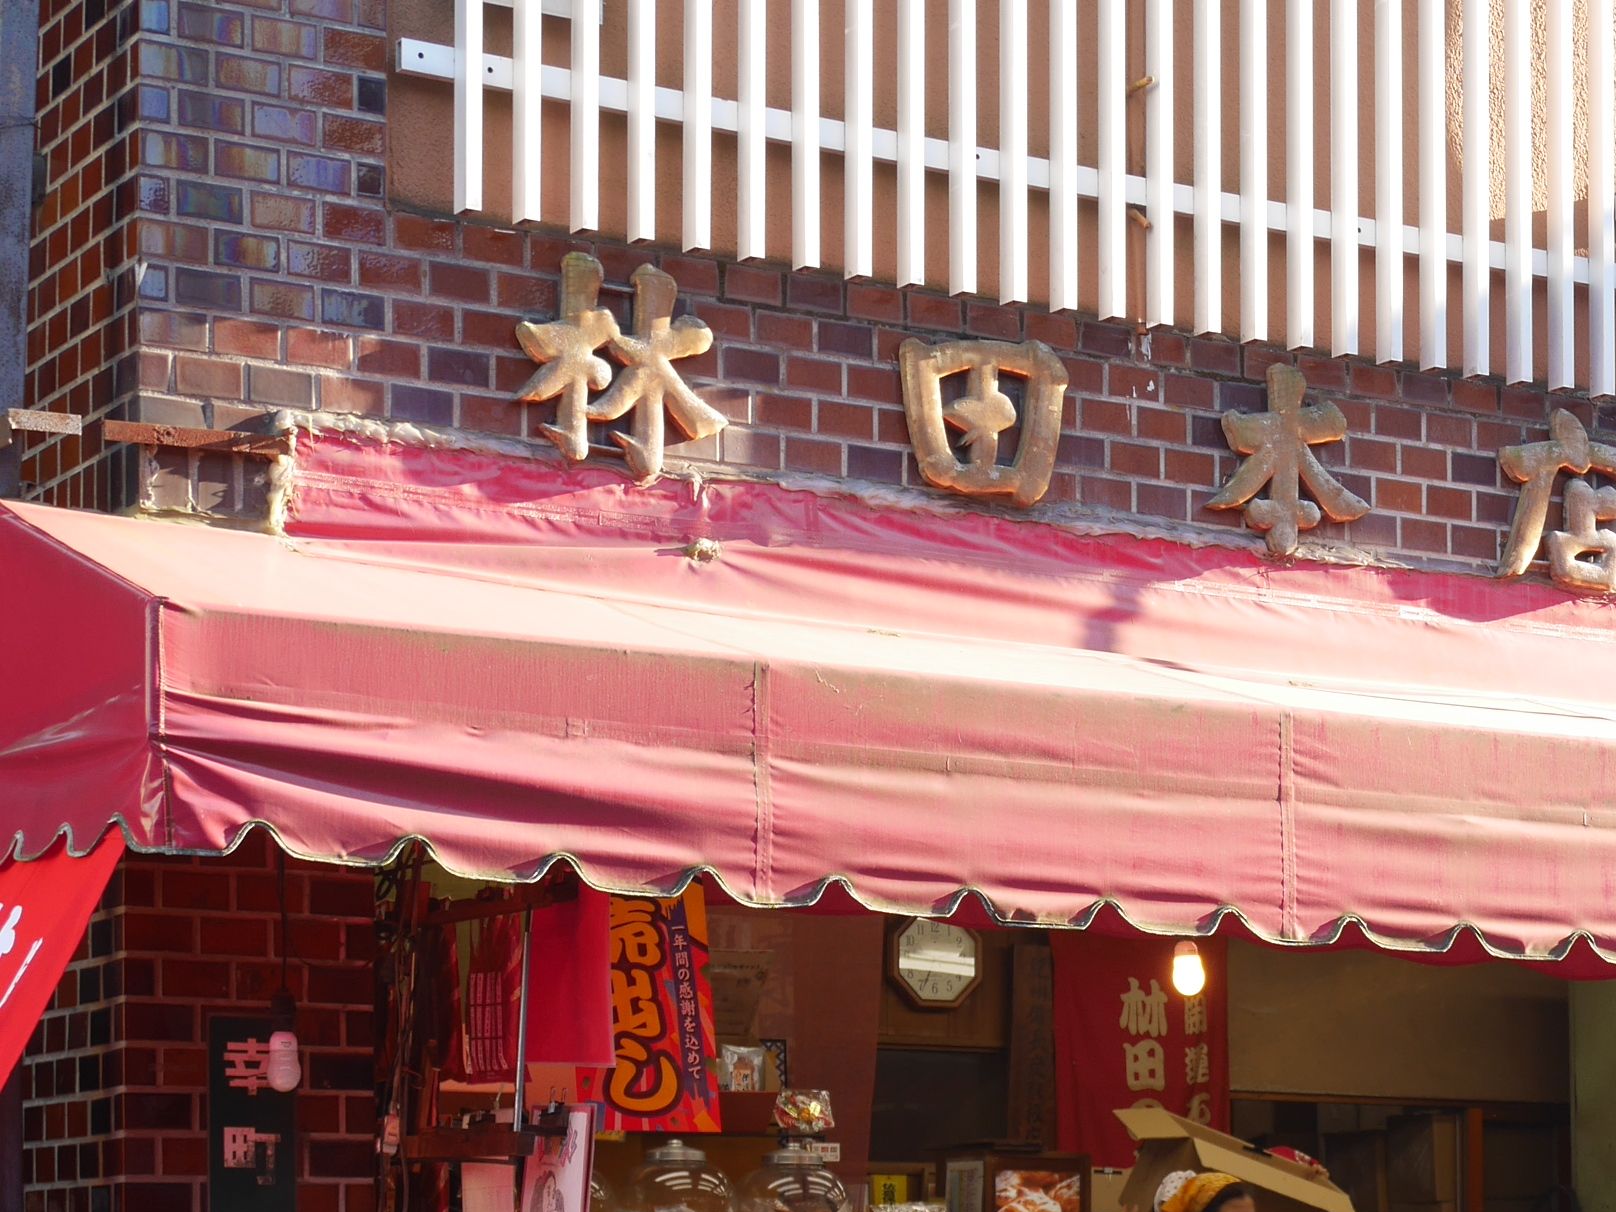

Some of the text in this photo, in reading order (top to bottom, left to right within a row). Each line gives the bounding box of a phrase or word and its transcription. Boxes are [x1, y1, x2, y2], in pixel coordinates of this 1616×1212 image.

[670, 924, 702, 1080] 一年間の感謝を込めて
